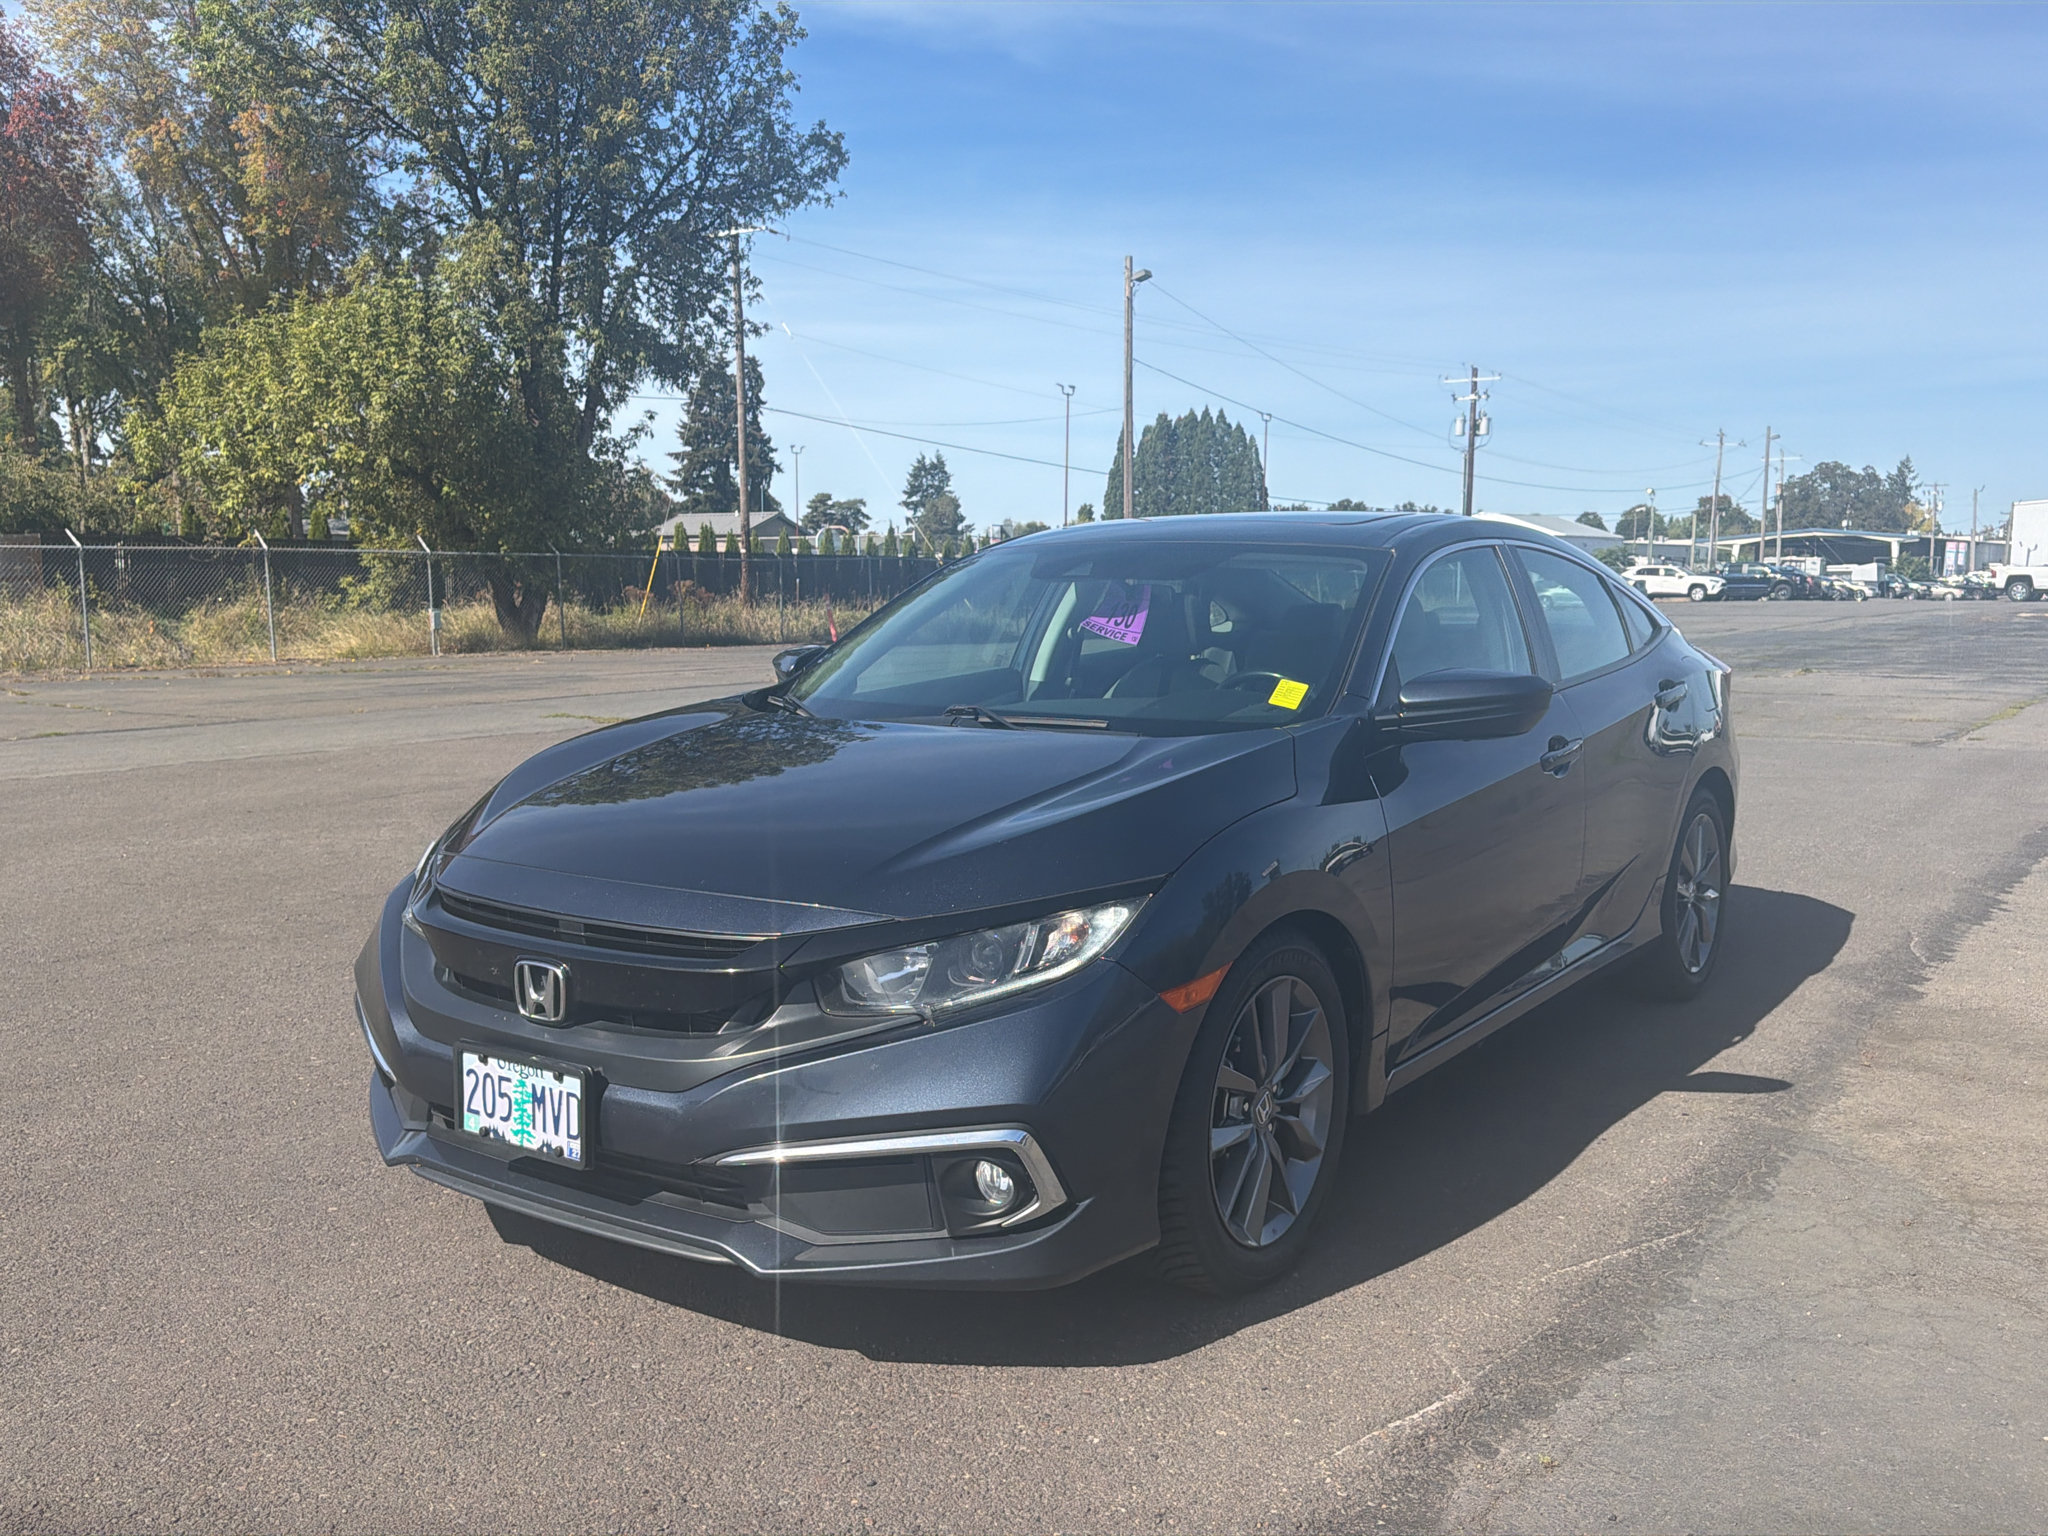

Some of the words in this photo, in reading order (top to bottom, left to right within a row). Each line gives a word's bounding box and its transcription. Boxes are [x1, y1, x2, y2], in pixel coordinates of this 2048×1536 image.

[1083, 620, 1128, 641] SERVICE
[497, 1058, 545, 1079] Oregon
[466, 1068, 512, 1122] 205
[532, 1083, 580, 1140] MVD
